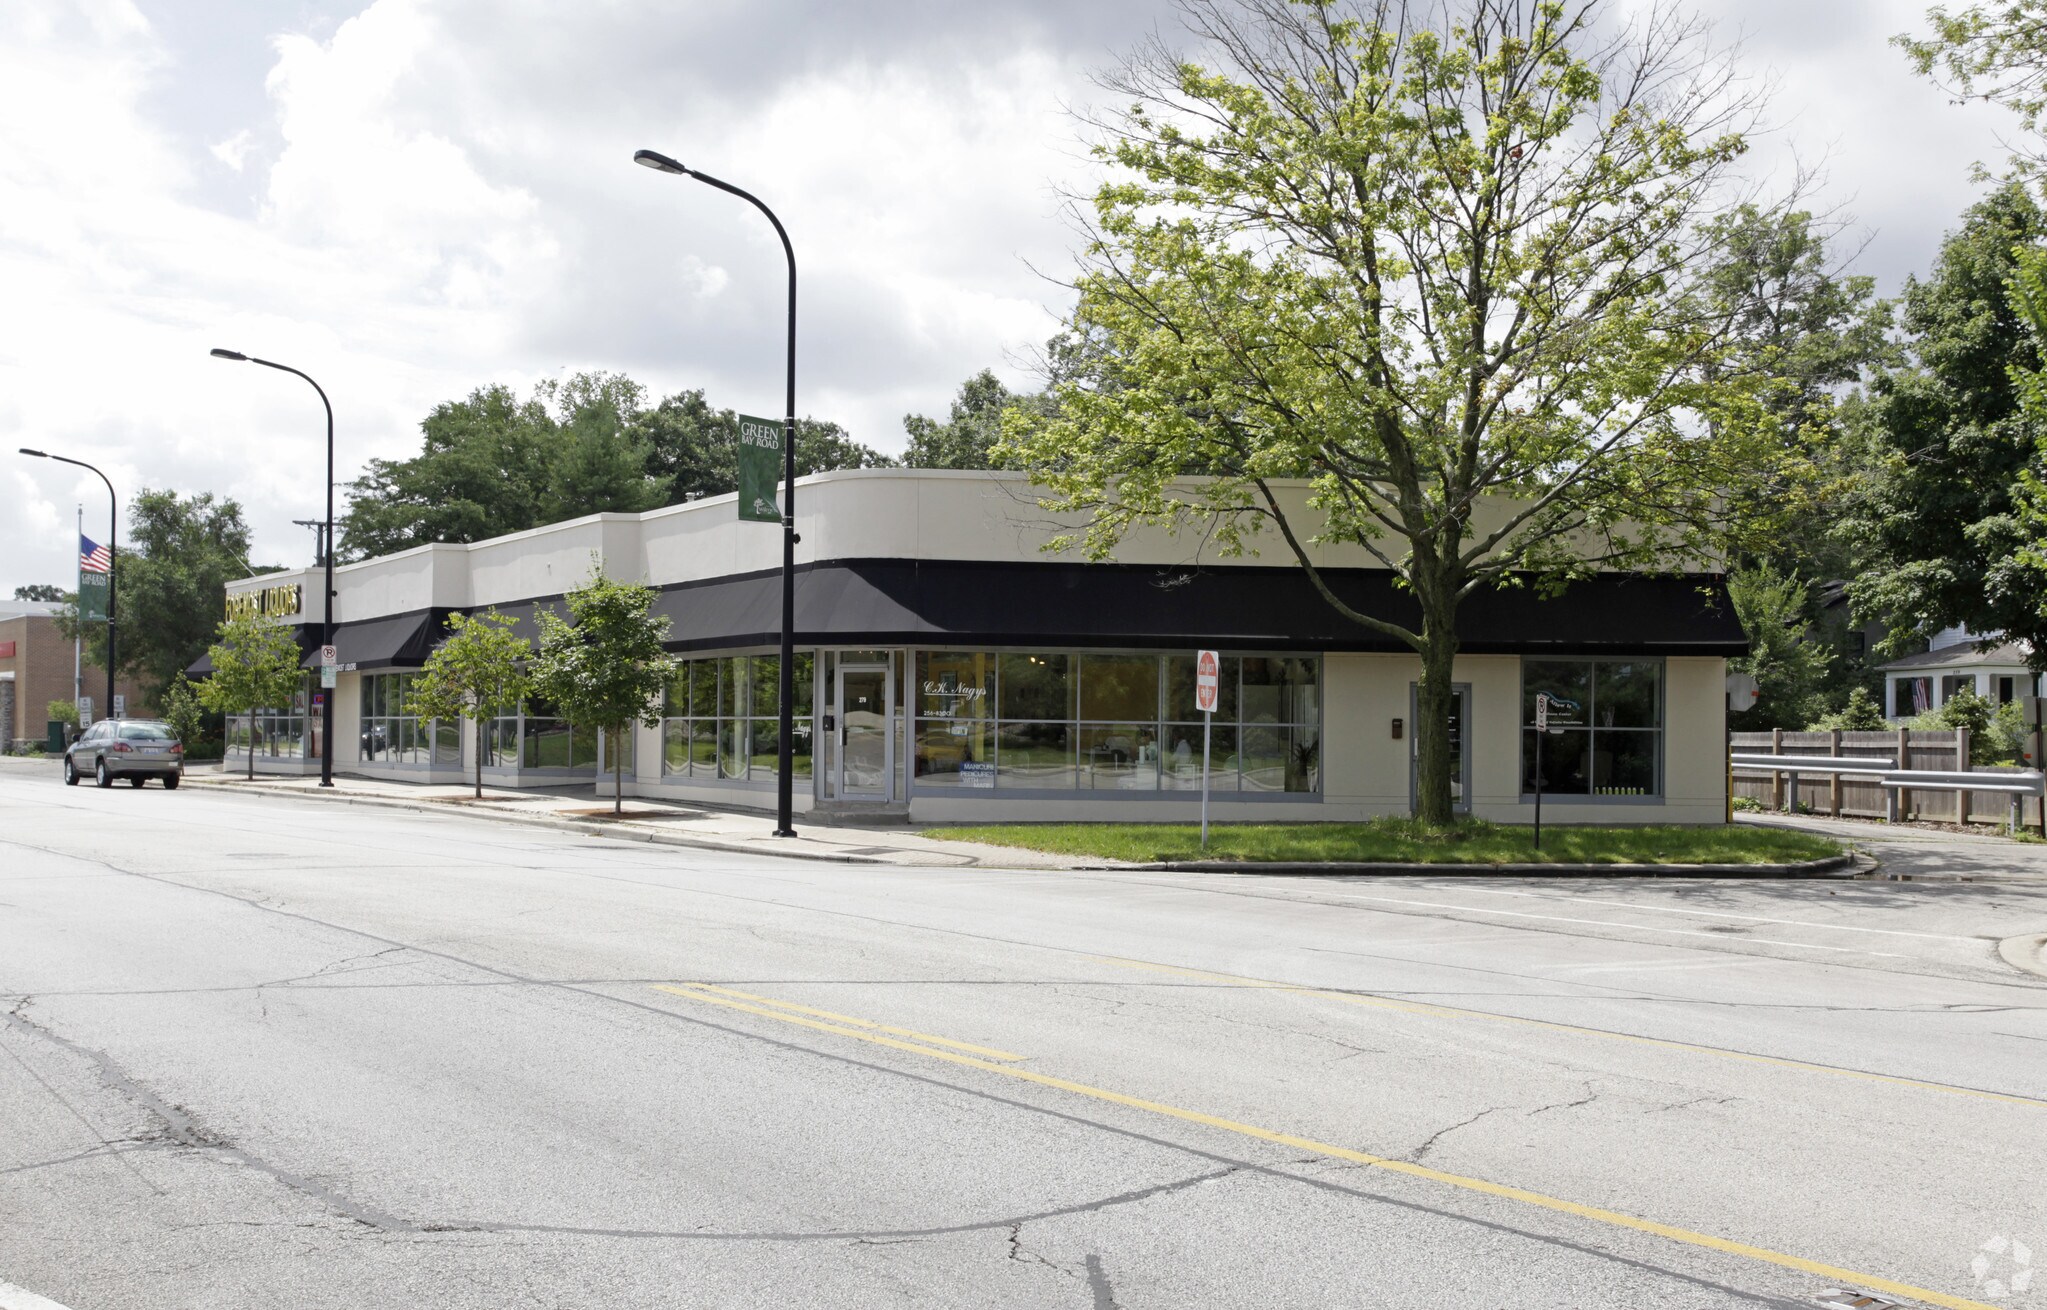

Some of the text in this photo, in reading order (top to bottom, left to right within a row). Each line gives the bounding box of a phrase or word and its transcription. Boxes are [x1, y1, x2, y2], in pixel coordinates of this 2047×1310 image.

[741, 422, 779, 440] GREEN
[741, 434, 779, 449] BAY ROAD
[81, 573, 106, 582] GREEN
[264, 583, 300, 617] LIQUORS
[1200, 662, 1206, 671] DO
[923, 681, 987, 701] C.K. Nagys
[1200, 689, 1212, 698] ENTER
[83, 720, 91, 728] 15
